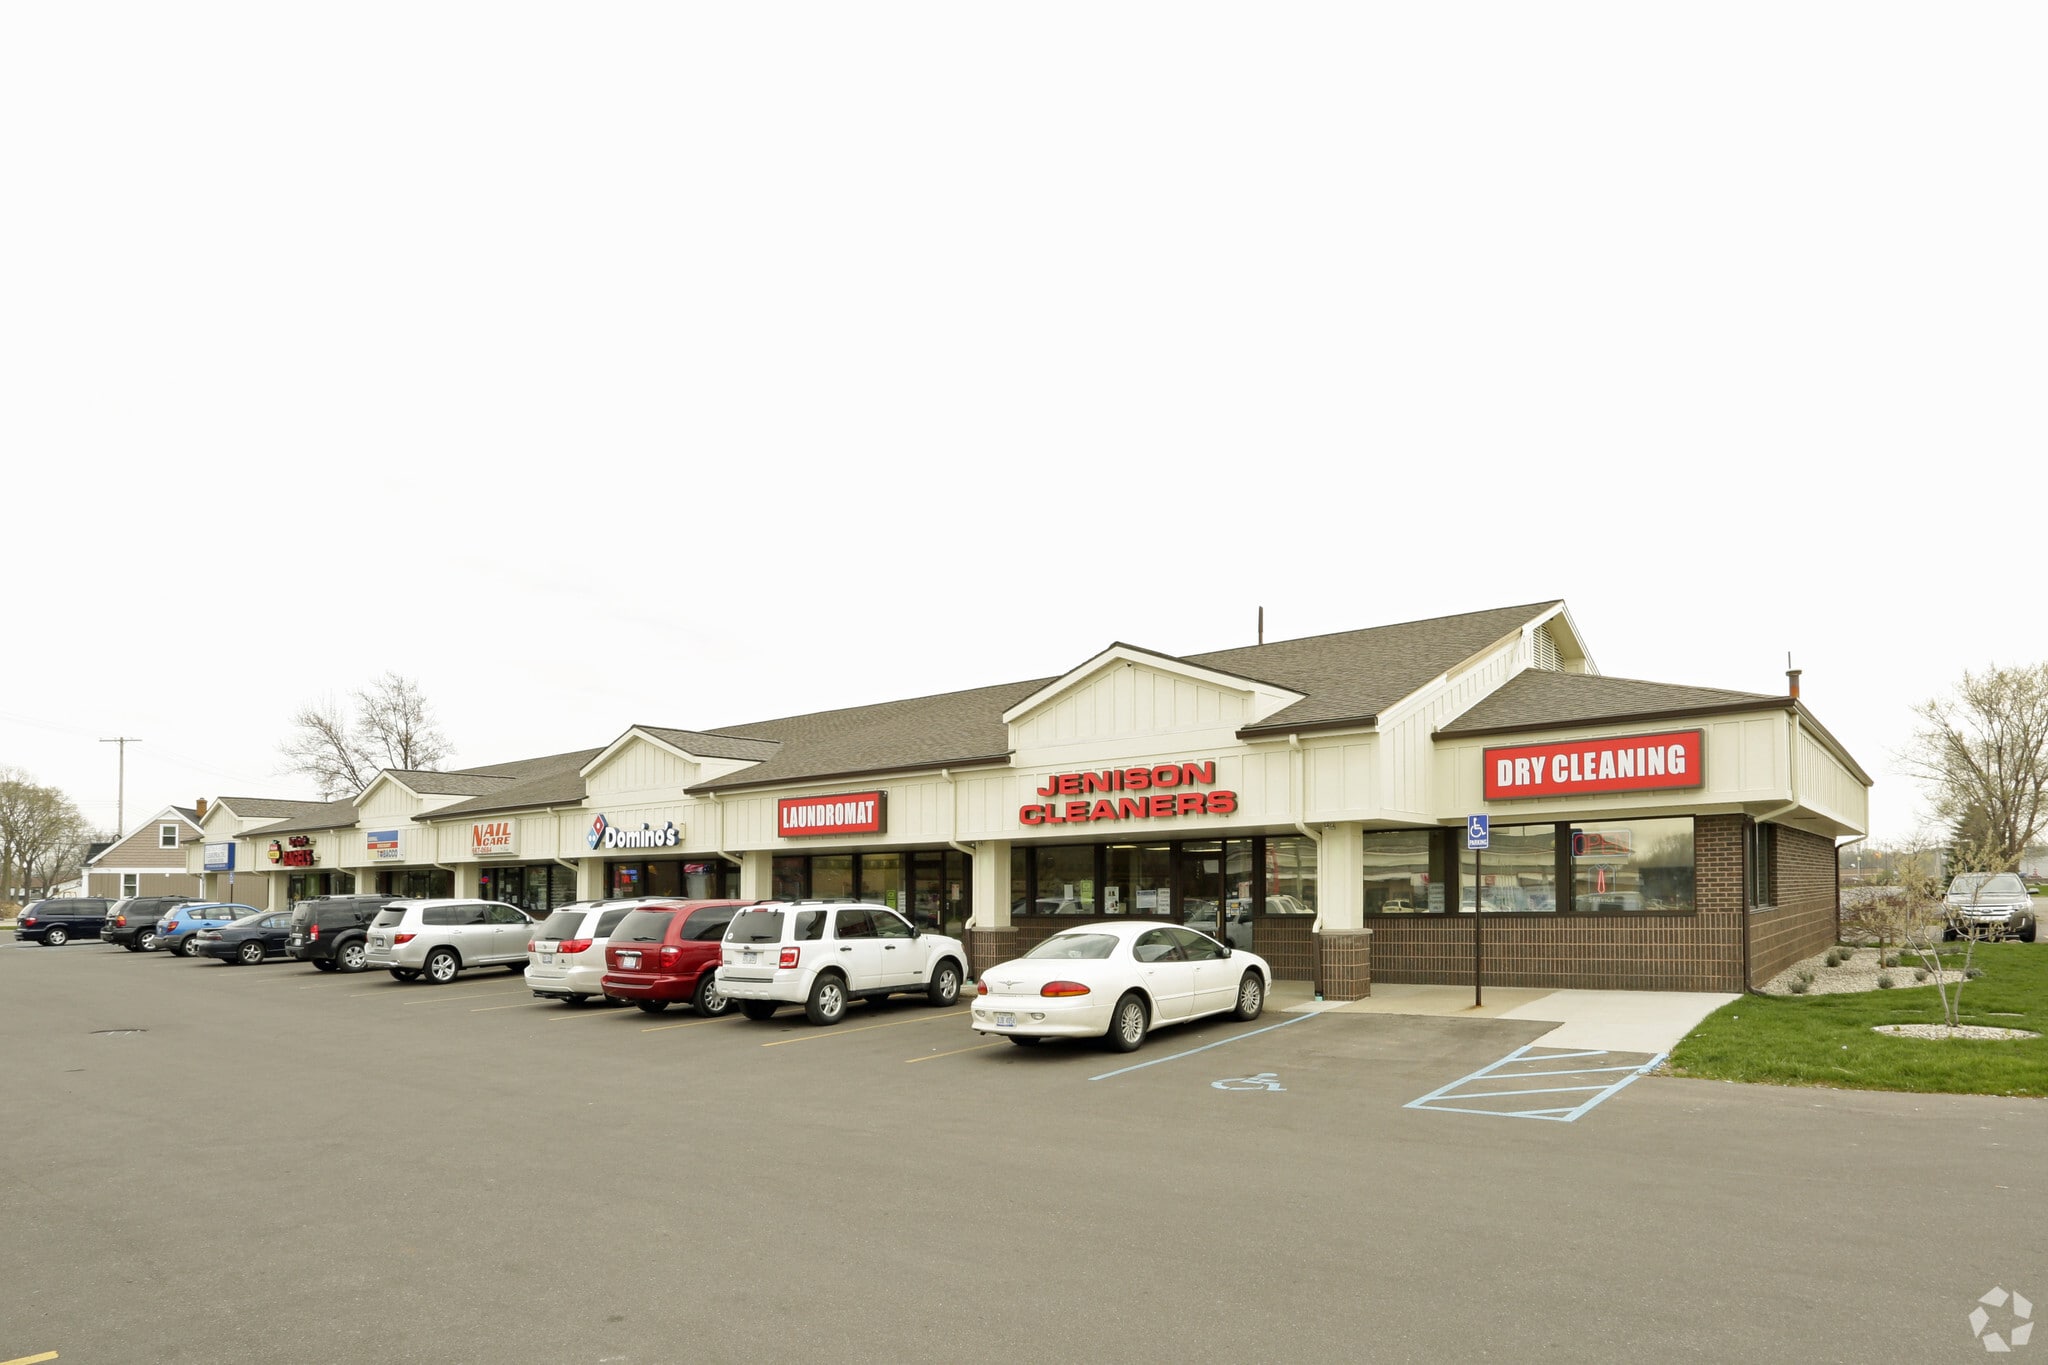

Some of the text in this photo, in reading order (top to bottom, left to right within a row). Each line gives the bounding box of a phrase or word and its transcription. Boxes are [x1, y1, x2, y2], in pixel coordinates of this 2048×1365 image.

[1037, 761, 1215, 797] JENISON
[1497, 744, 1686, 787] DRY CLEANING
[783, 800, 875, 829] LAUNDROMAT
[1019, 790, 1237, 825] CLEANERS
[472, 822, 512, 847] NAIL
[482, 836, 510, 847] CARE
[605, 821, 679, 849] Domino's
[1574, 832, 1629, 855] OPEN
